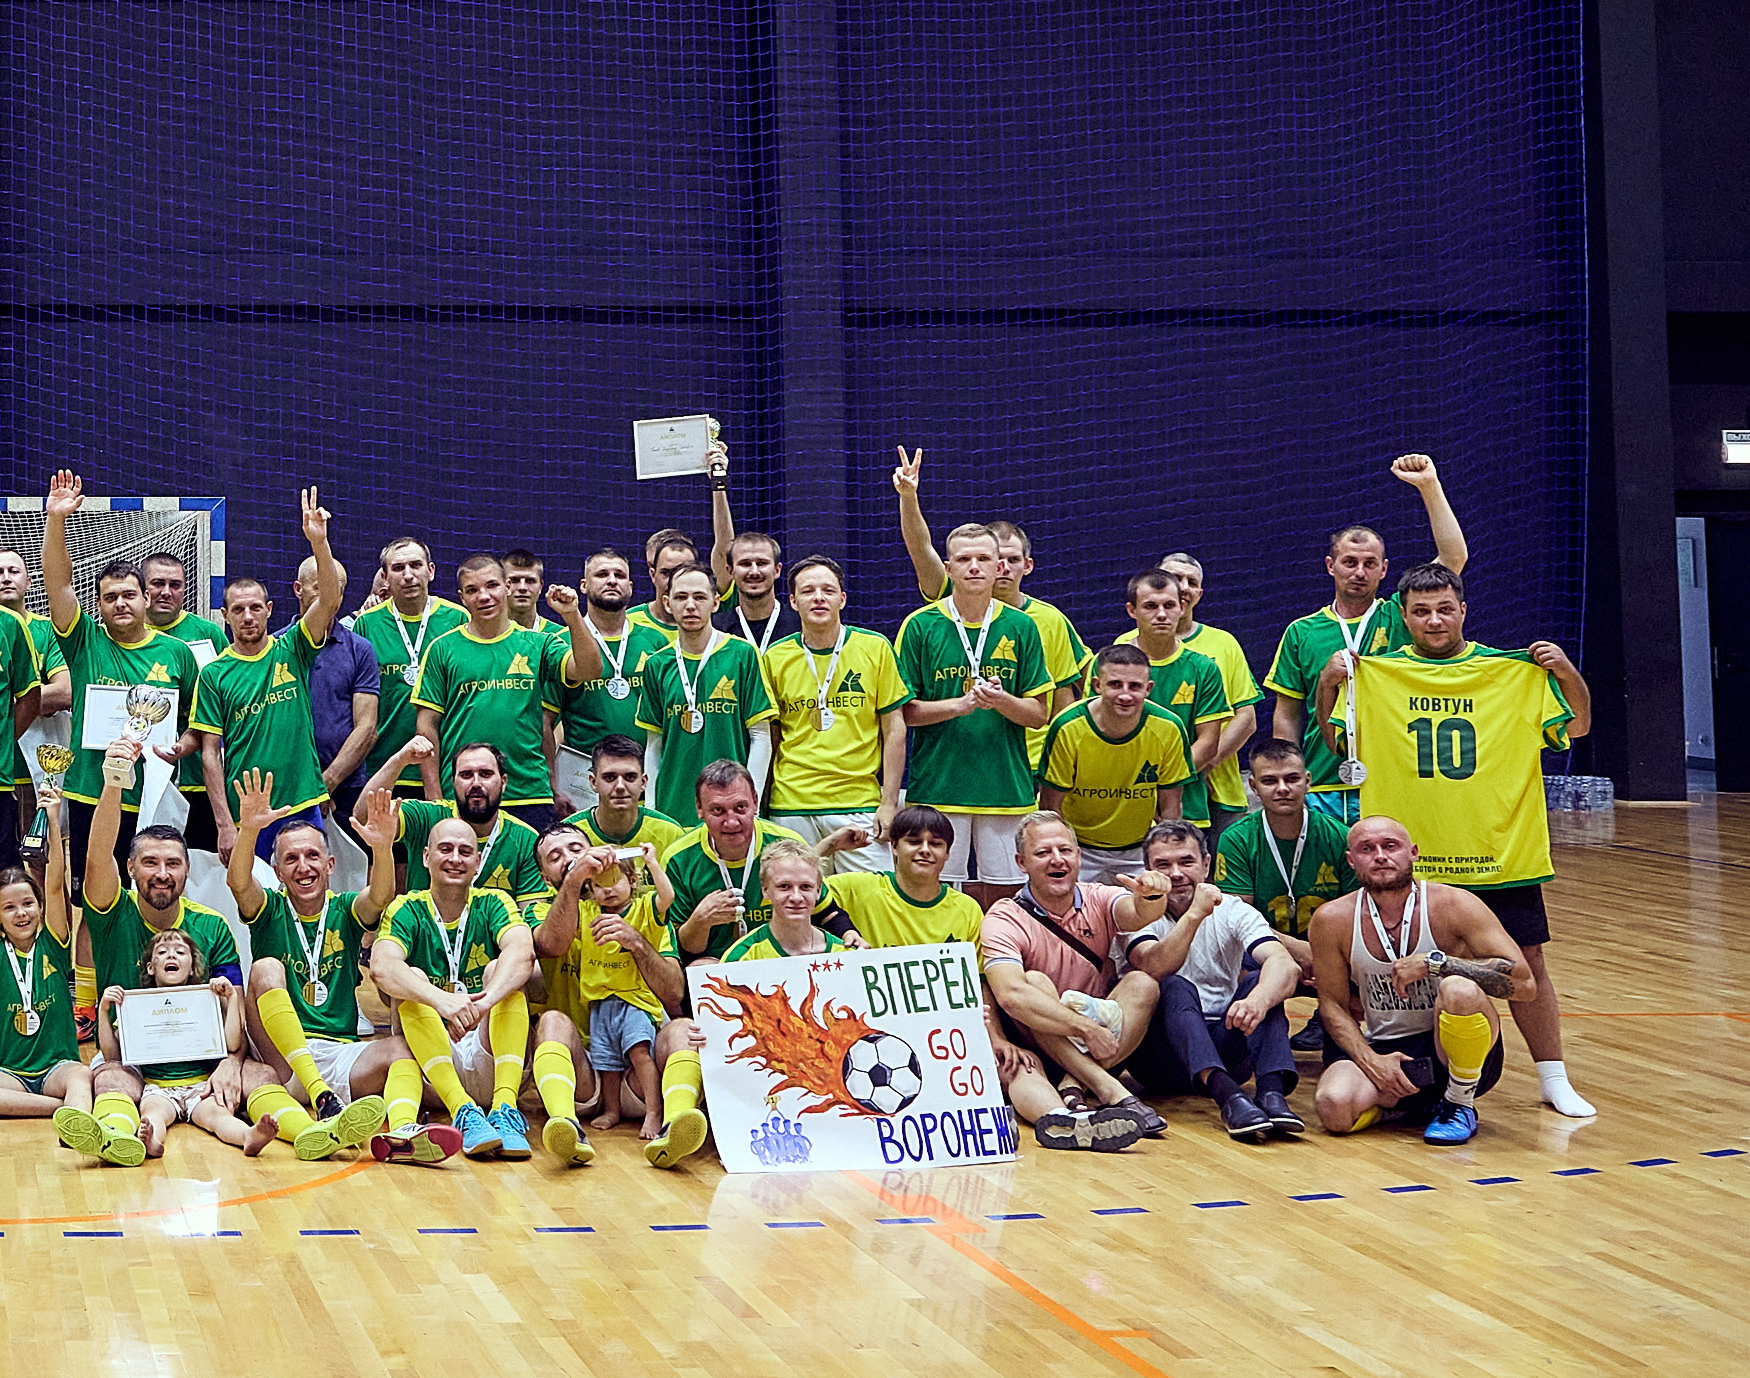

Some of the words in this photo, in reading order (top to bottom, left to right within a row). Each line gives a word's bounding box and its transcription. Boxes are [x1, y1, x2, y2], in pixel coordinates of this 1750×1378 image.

[459, 678, 536, 695] АГРОИНВЕСТ
[787, 696, 867, 714] АГРОНВЕСТ
[1408, 697, 1473, 715] КОВТУН
[1407, 717, 1477, 780] 10
[1072, 787, 1156, 800] АГРОИНВЕСТ
[862, 948, 979, 1018] ВПЕРЁД
[151, 1006, 188, 1016] ДИПЛОМ
[927, 1028, 967, 1061] GO
[949, 1065, 984, 1097] GO
[877, 1106, 1015, 1165] ВОРОНЕЖ
